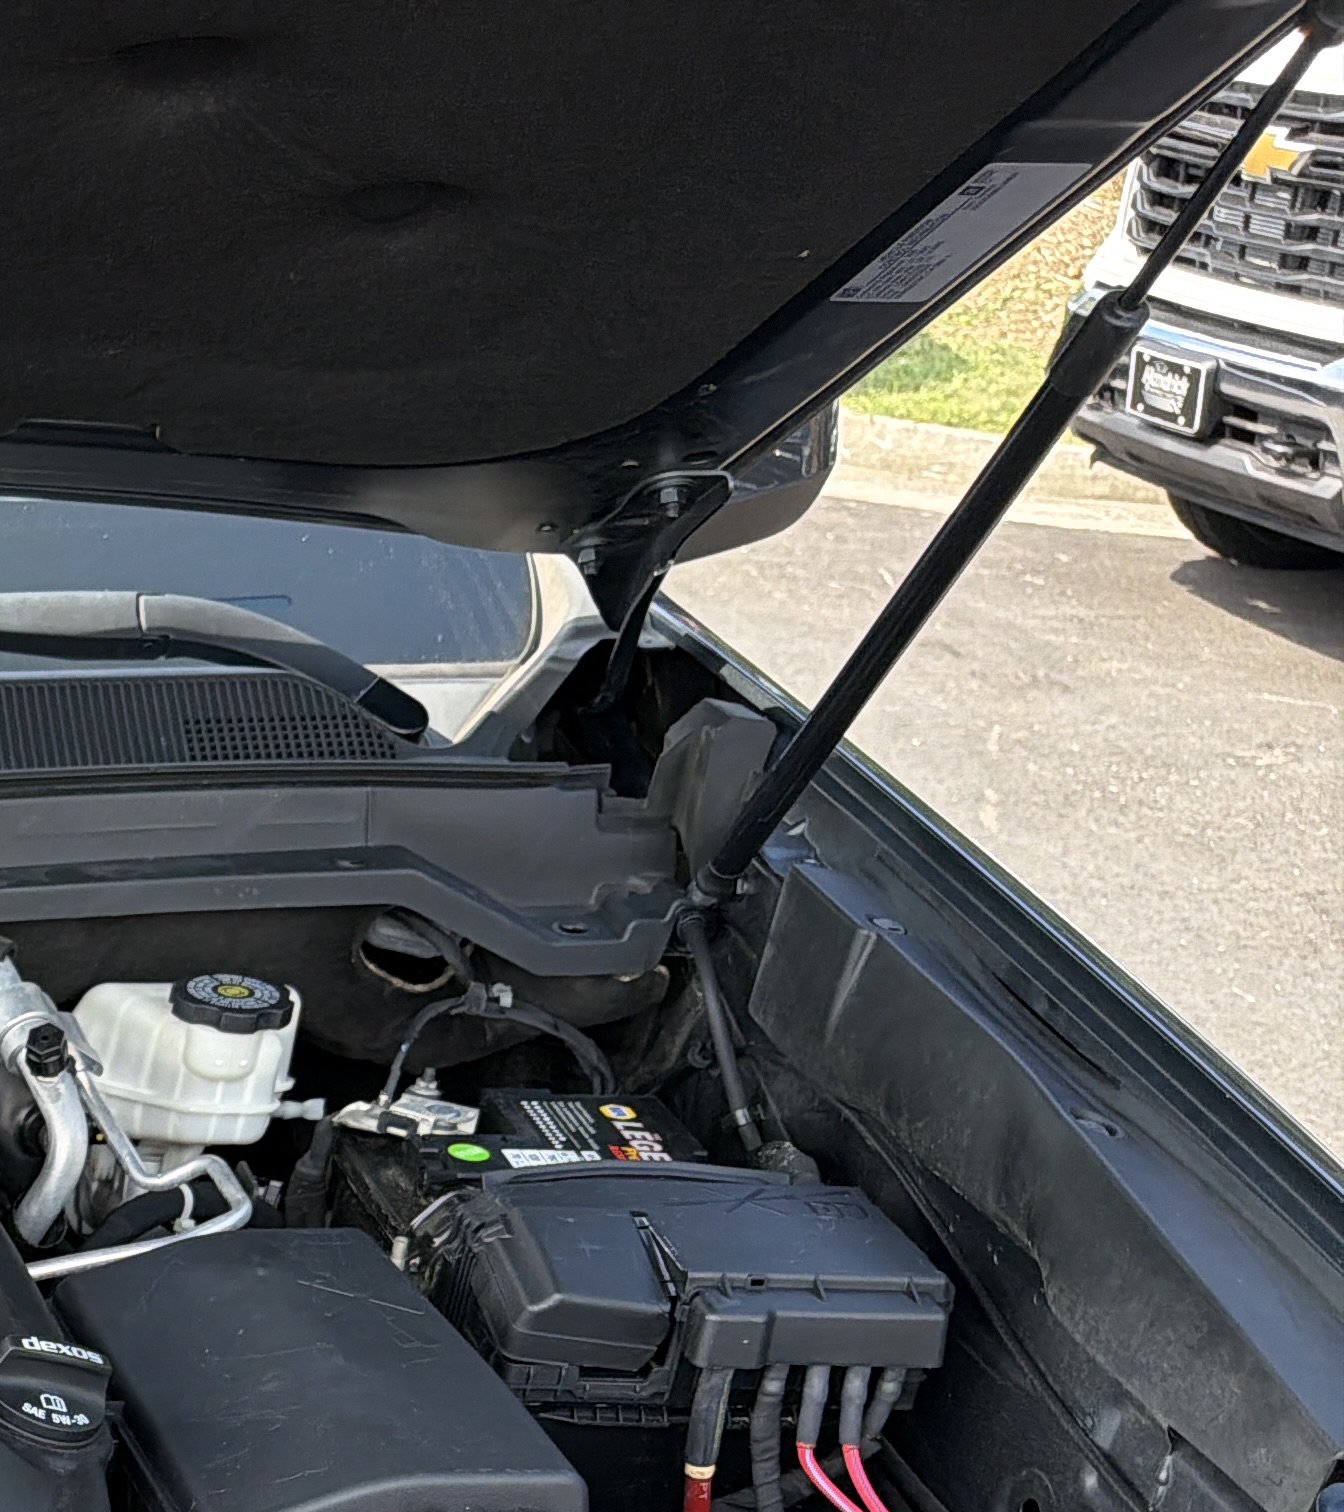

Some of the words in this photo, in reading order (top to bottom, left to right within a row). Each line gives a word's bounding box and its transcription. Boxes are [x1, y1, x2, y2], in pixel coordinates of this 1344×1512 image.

[21, 1336, 104, 1365] dexos
[21, 1402, 47, 1420] SAE
[51, 1413, 91, 1426] 5W-30
